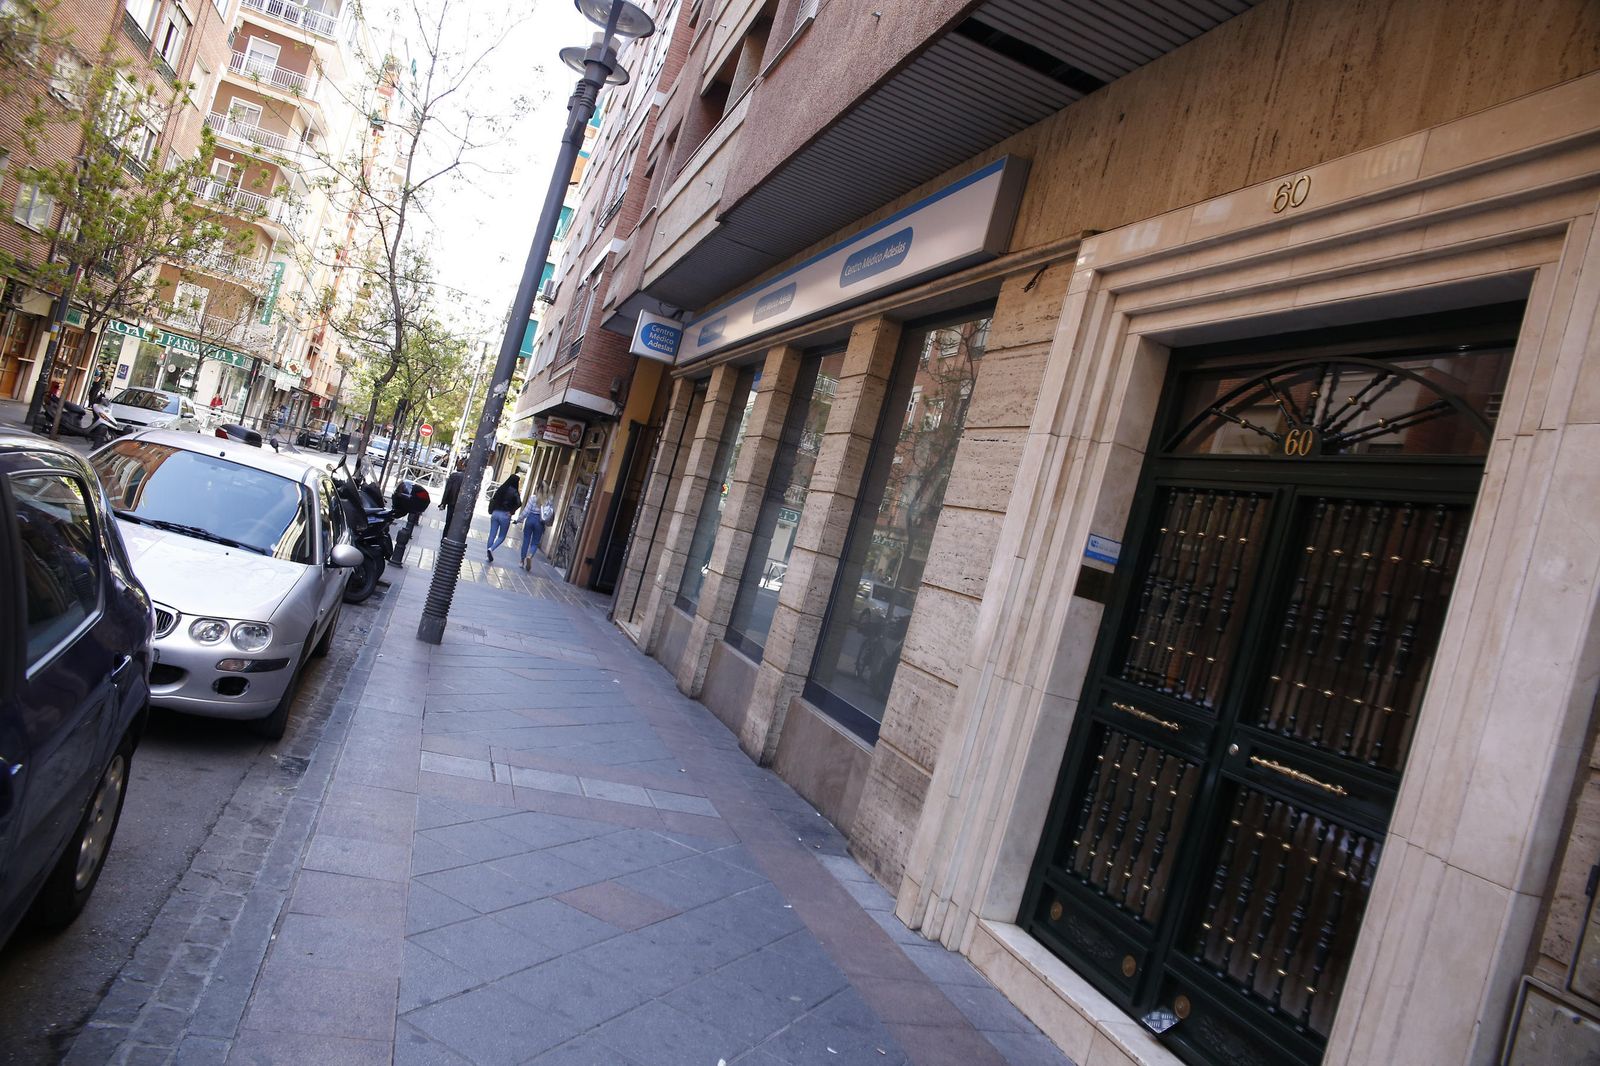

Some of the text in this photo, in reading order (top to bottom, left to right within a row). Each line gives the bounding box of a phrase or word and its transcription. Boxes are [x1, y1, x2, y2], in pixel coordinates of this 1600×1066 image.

[1272, 174, 1312, 214] 60
[844, 261, 863, 277] Centro
[883, 240, 907, 262] Adeslas
[648, 331, 675, 345] Médico
[651, 324, 675, 337] Centro
[647, 339, 674, 353] Adeslas
[1285, 429, 1313, 457] 60
